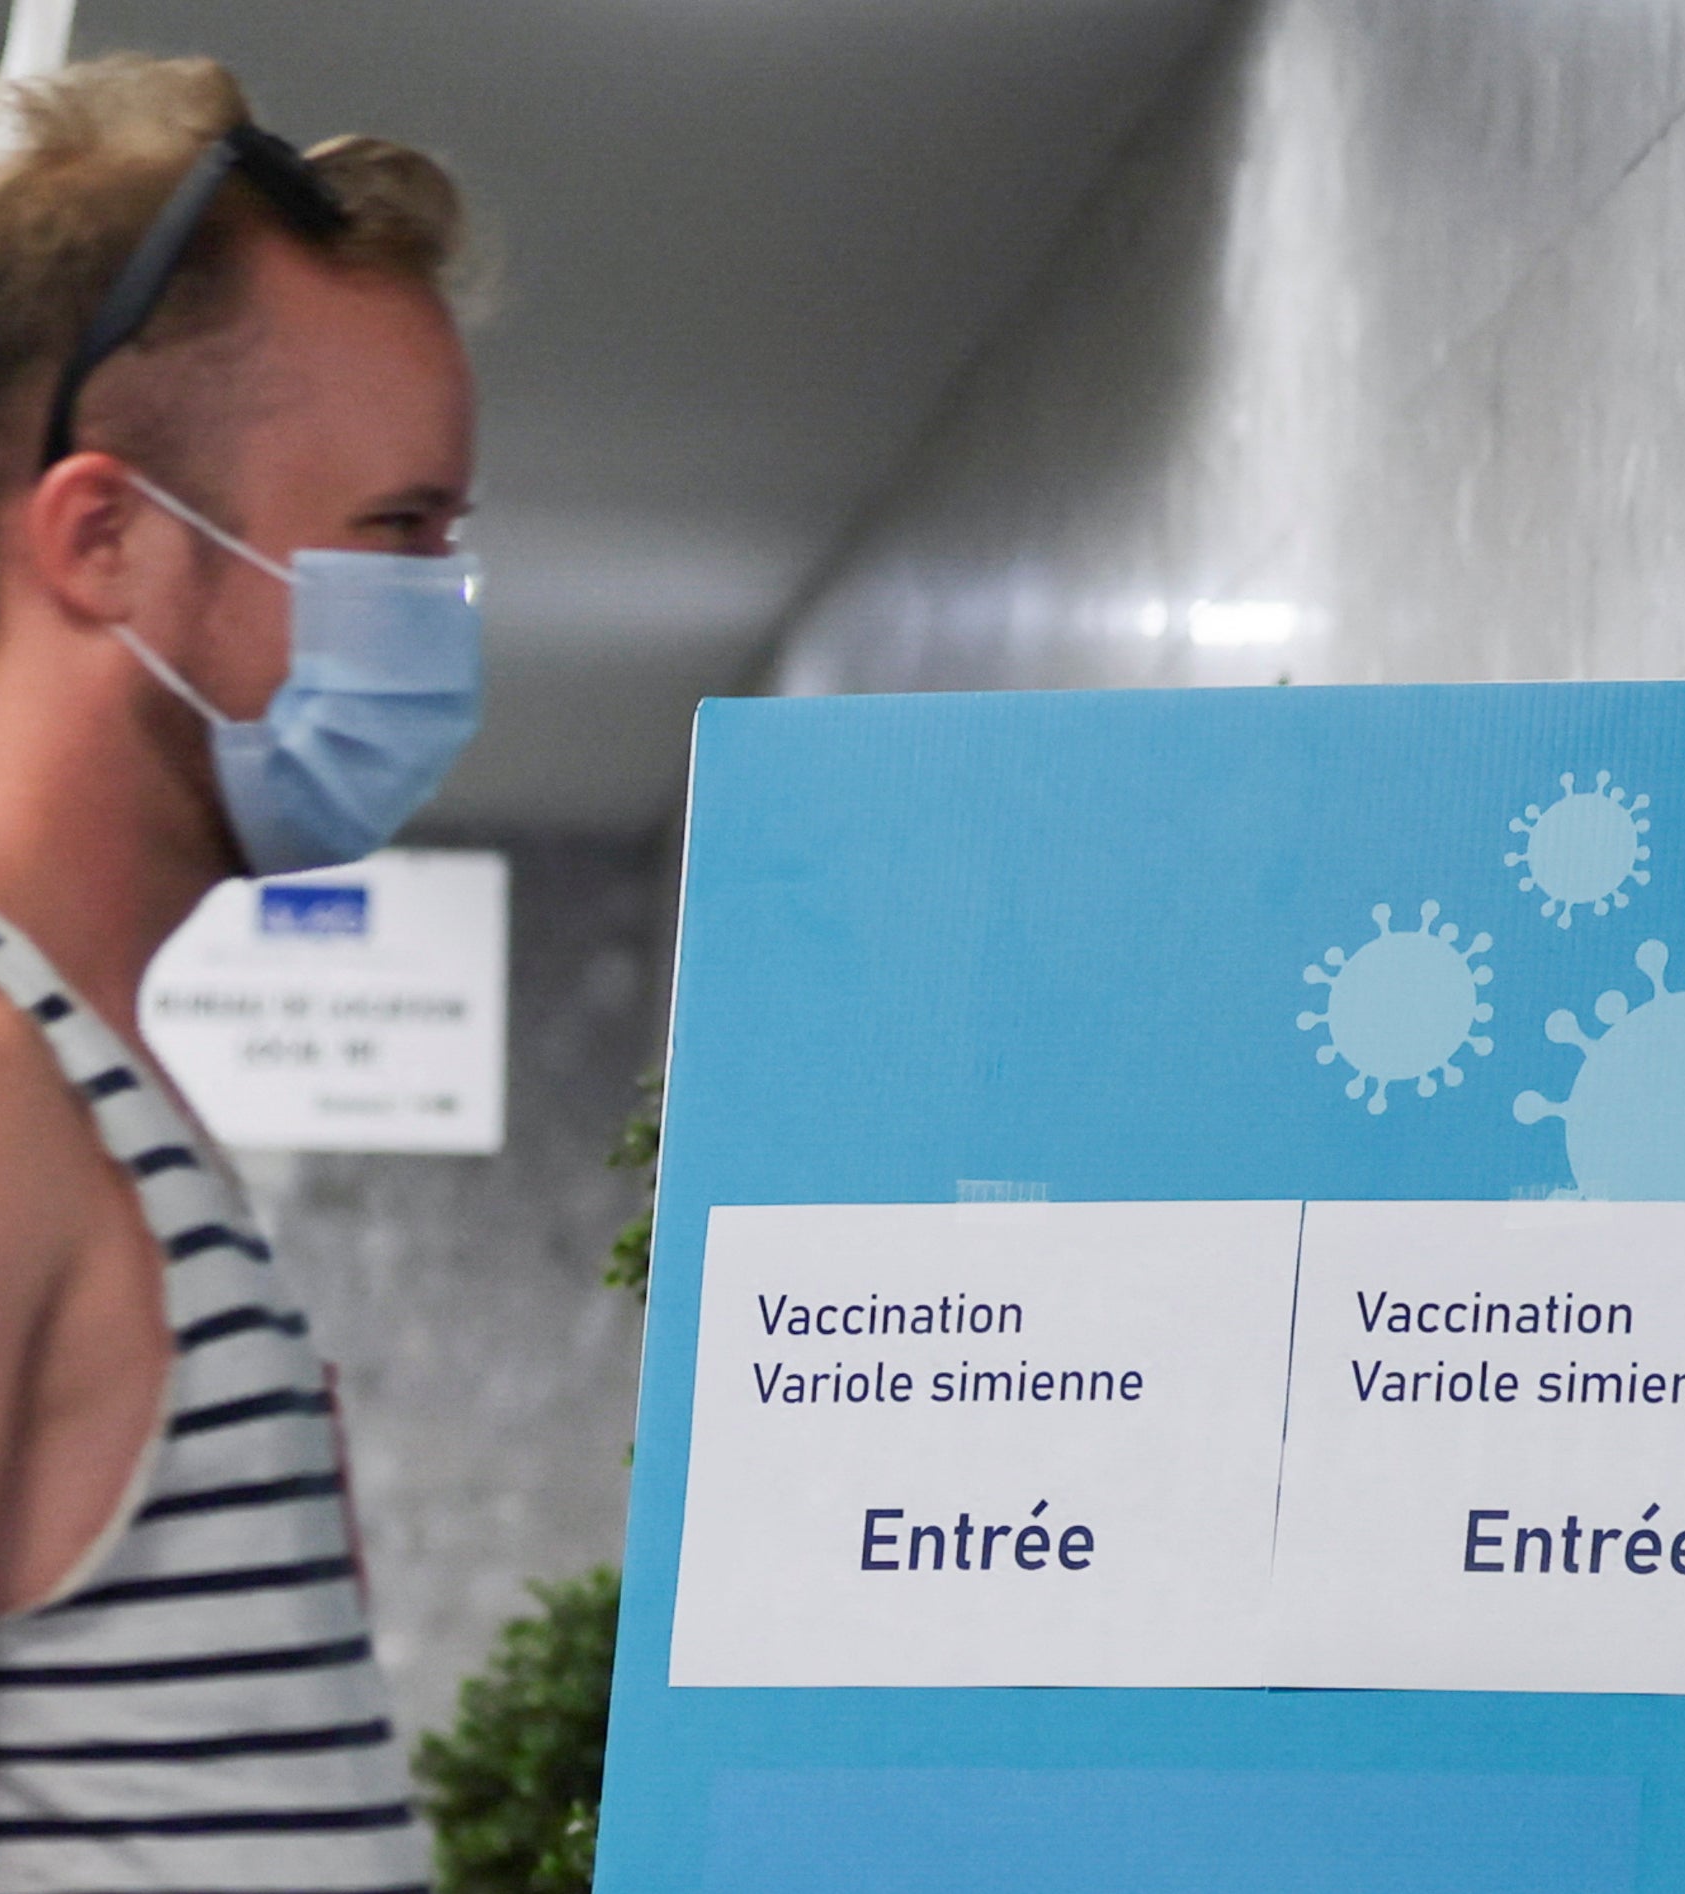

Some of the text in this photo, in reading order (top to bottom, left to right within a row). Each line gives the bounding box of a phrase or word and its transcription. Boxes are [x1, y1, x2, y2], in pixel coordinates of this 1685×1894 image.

[757, 1292, 1023, 1336] Vaccination
[1356, 1290, 1633, 1335] Vaccination
[753, 1359, 1144, 1404] Variole simienne
[1351, 1359, 1519, 1403] Variole
[860, 1498, 1095, 1571] Entrée
